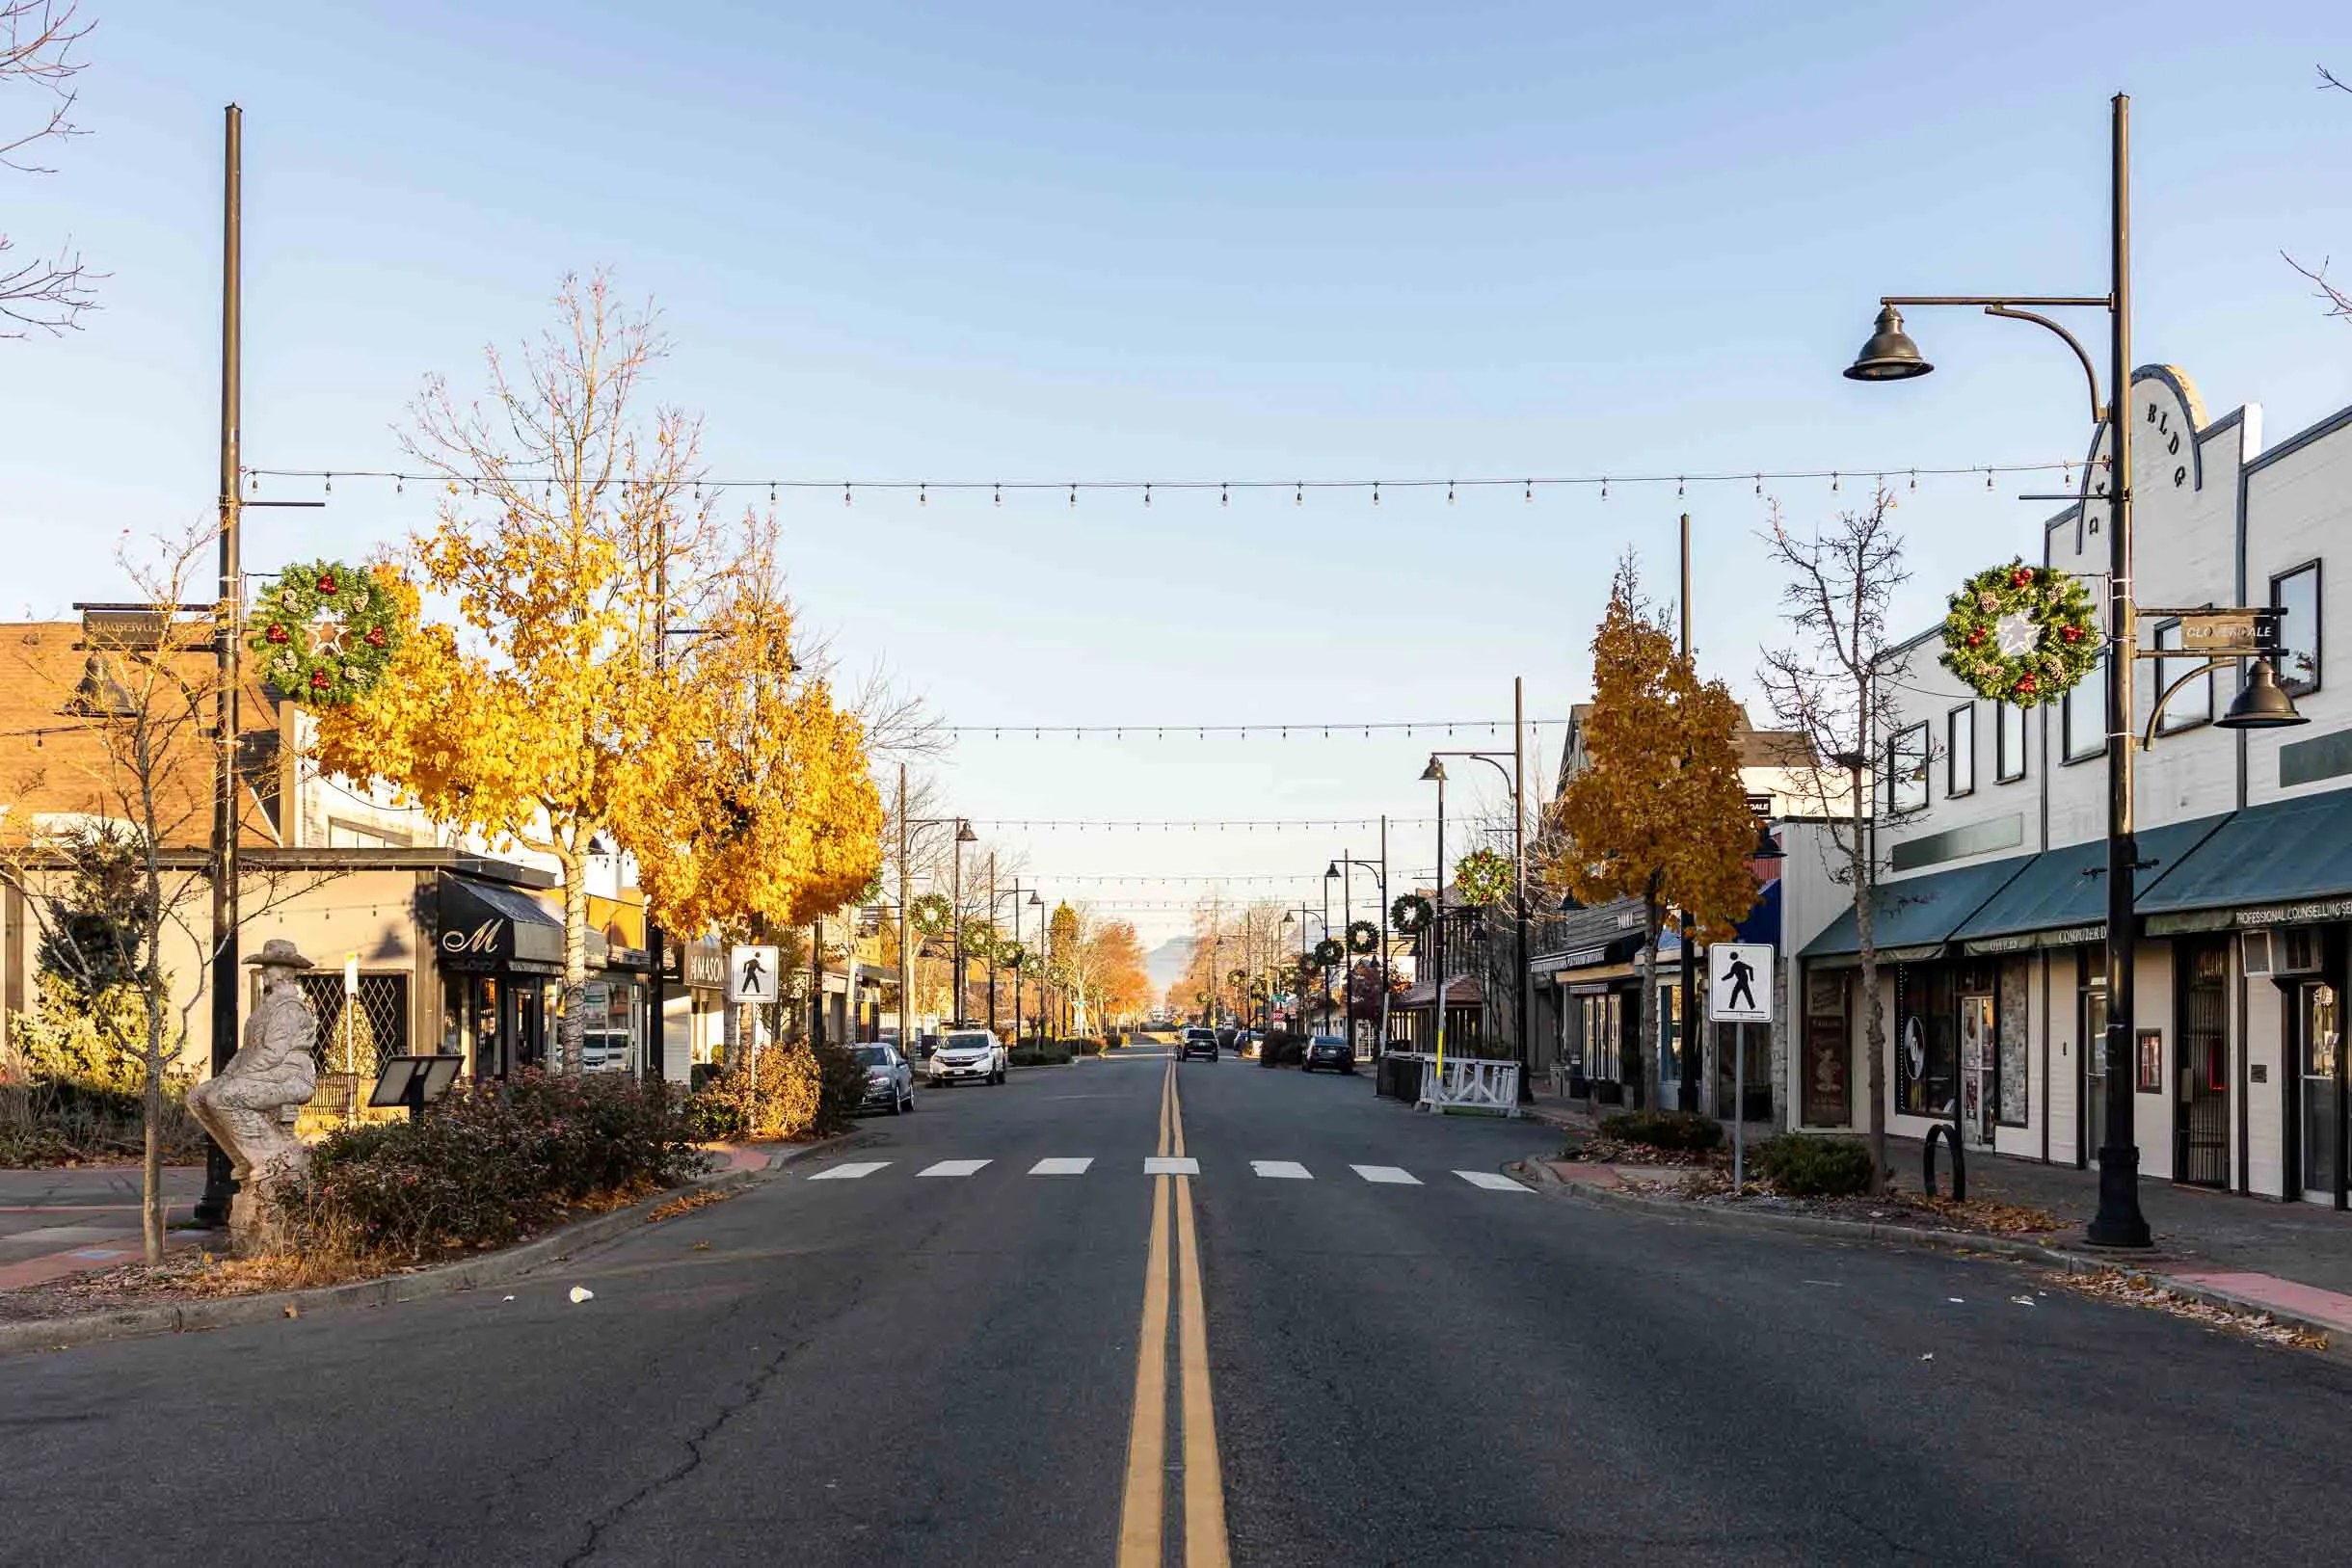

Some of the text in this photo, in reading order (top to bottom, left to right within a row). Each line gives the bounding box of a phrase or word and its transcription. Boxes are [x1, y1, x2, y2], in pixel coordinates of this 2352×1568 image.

[2236, 909, 2285, 924] PROFESSIONAL
[442, 918, 504, 952] M
[2058, 926, 2099, 943] COMPUTER
